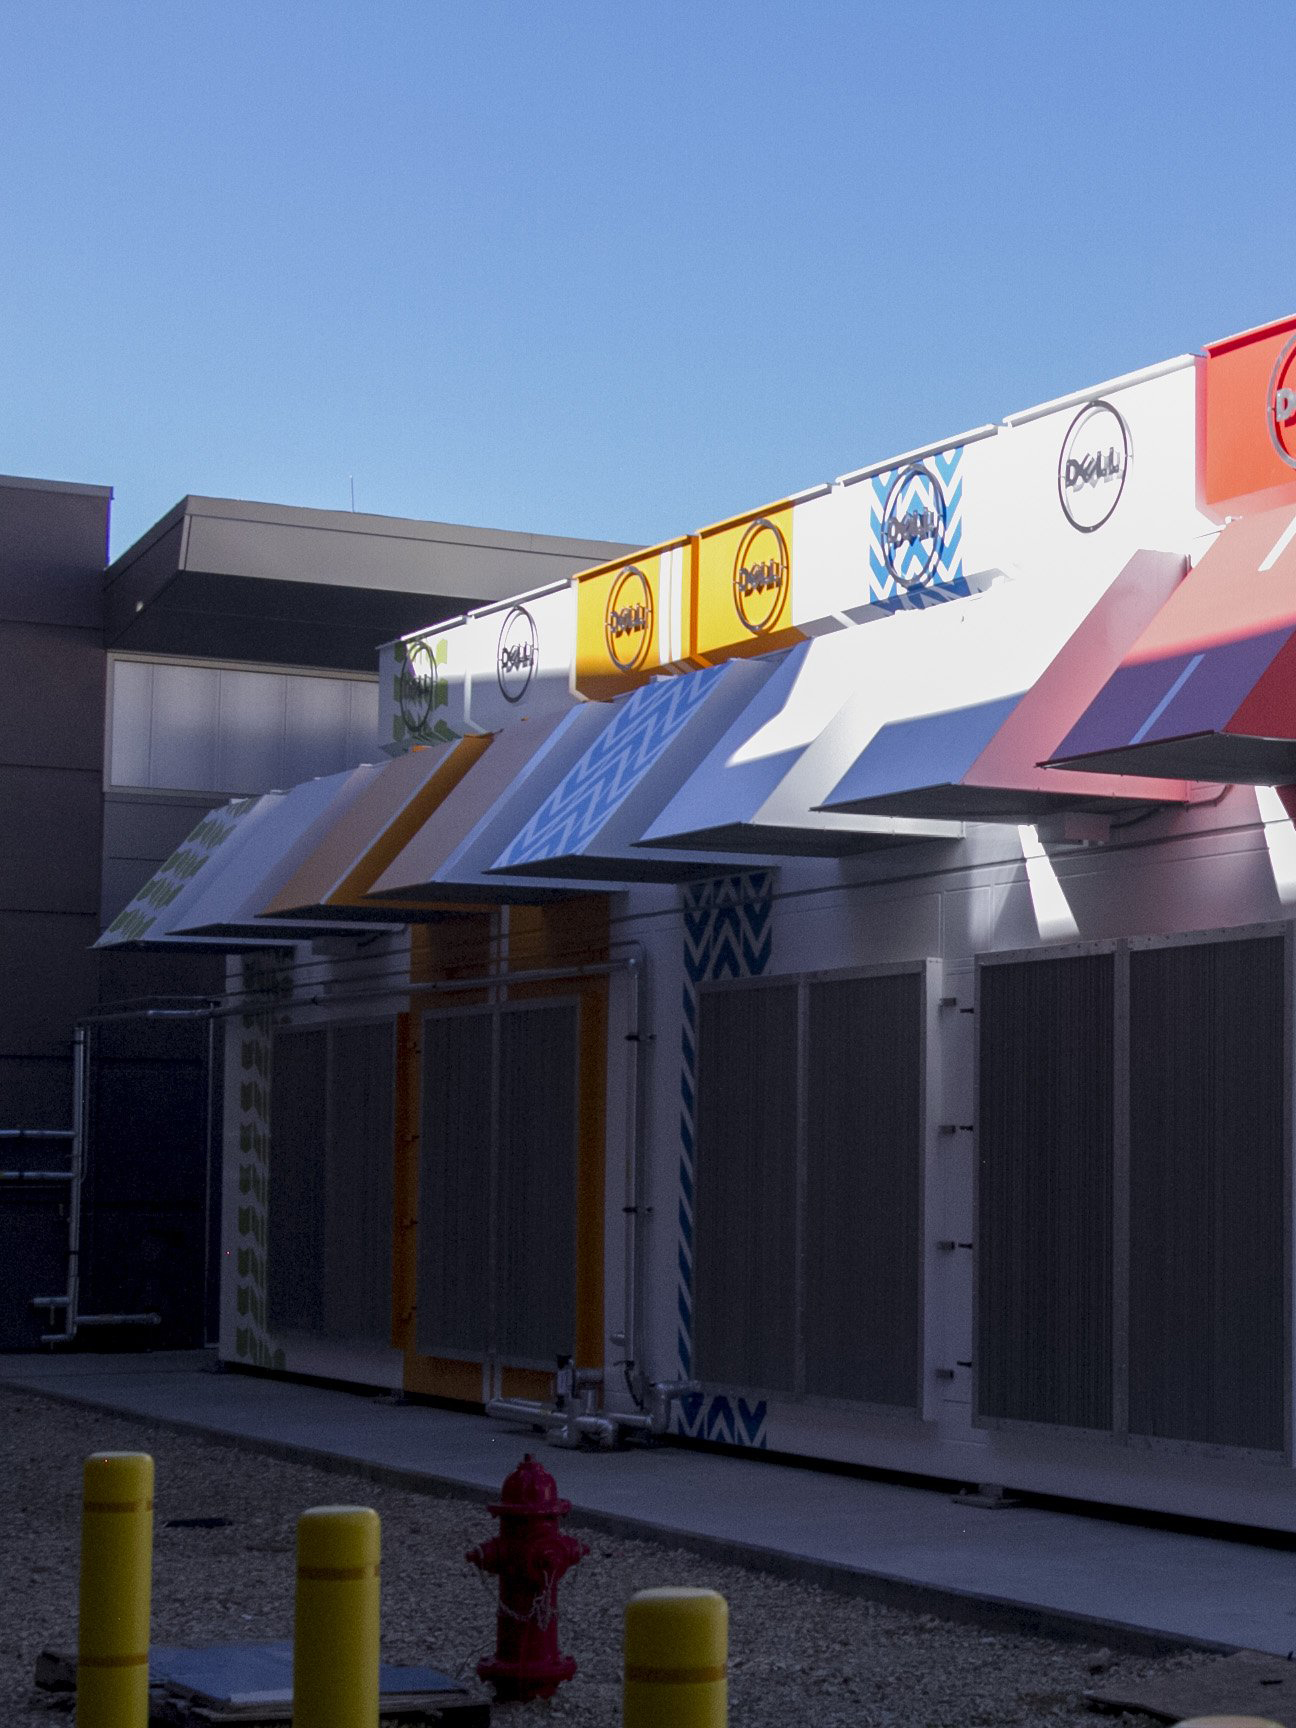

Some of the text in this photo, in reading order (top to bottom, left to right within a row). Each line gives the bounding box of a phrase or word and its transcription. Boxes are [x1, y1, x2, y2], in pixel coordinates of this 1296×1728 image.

[1066, 447, 1119, 488] DELL
[888, 507, 935, 544] DELL
[739, 558, 782, 593] DELL
[610, 602, 647, 634] DELL
[501, 641, 533, 669] DELL
